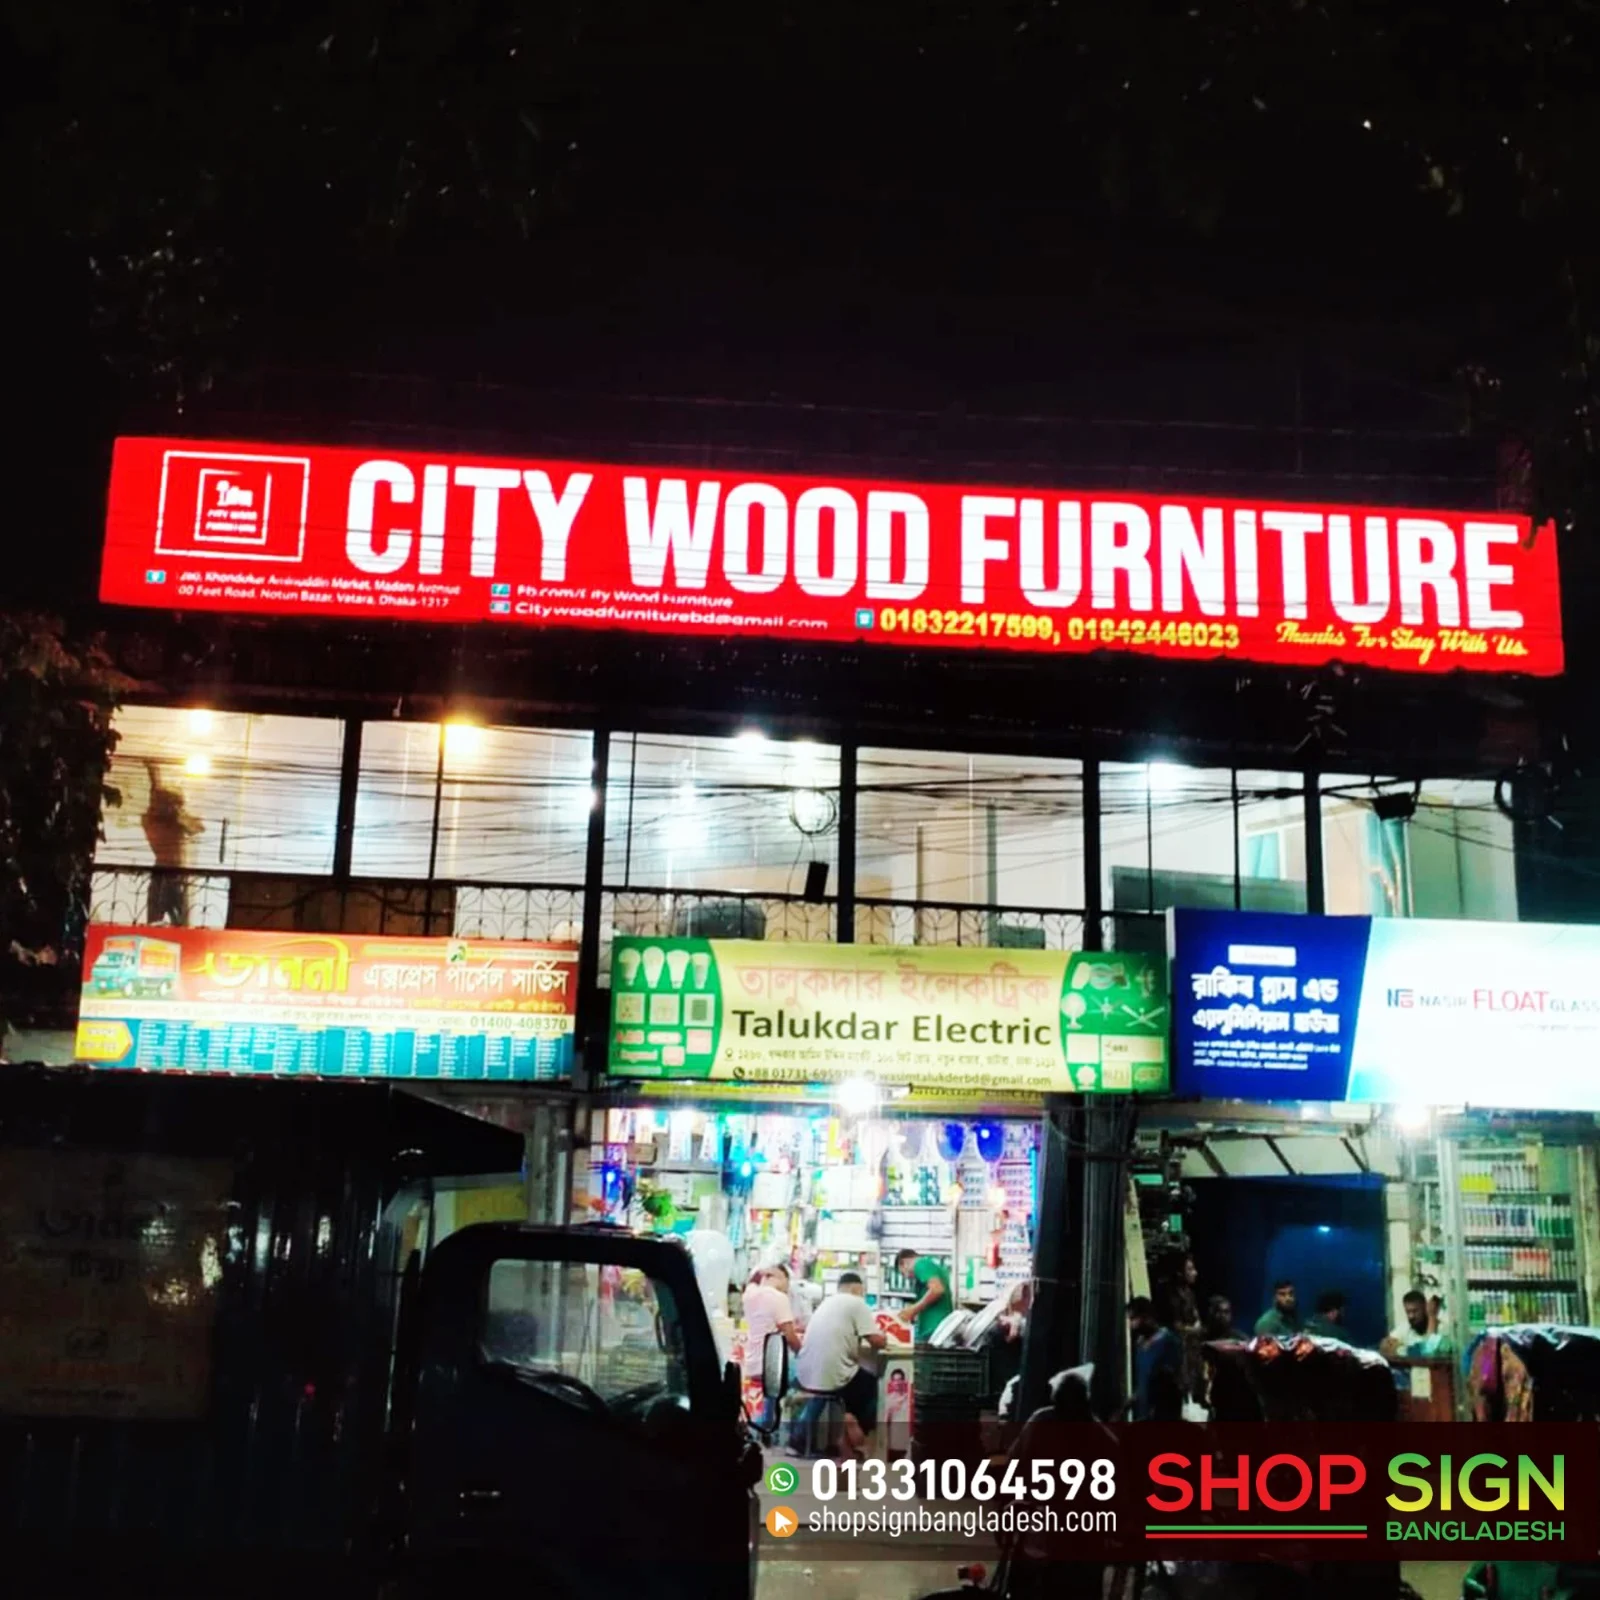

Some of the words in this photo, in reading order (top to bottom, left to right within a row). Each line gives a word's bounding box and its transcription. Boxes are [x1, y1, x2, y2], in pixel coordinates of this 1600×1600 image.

[346, 461, 592, 581] CITY
[624, 477, 929, 599] WOOD
[962, 496, 1523, 628] FURNITURE
[734, 963, 888, 1012] তালুকদার
[1472, 988, 1549, 1013] FLOAT
[732, 1009, 899, 1041] Talukdar
[912, 1013, 1052, 1046] Electric
